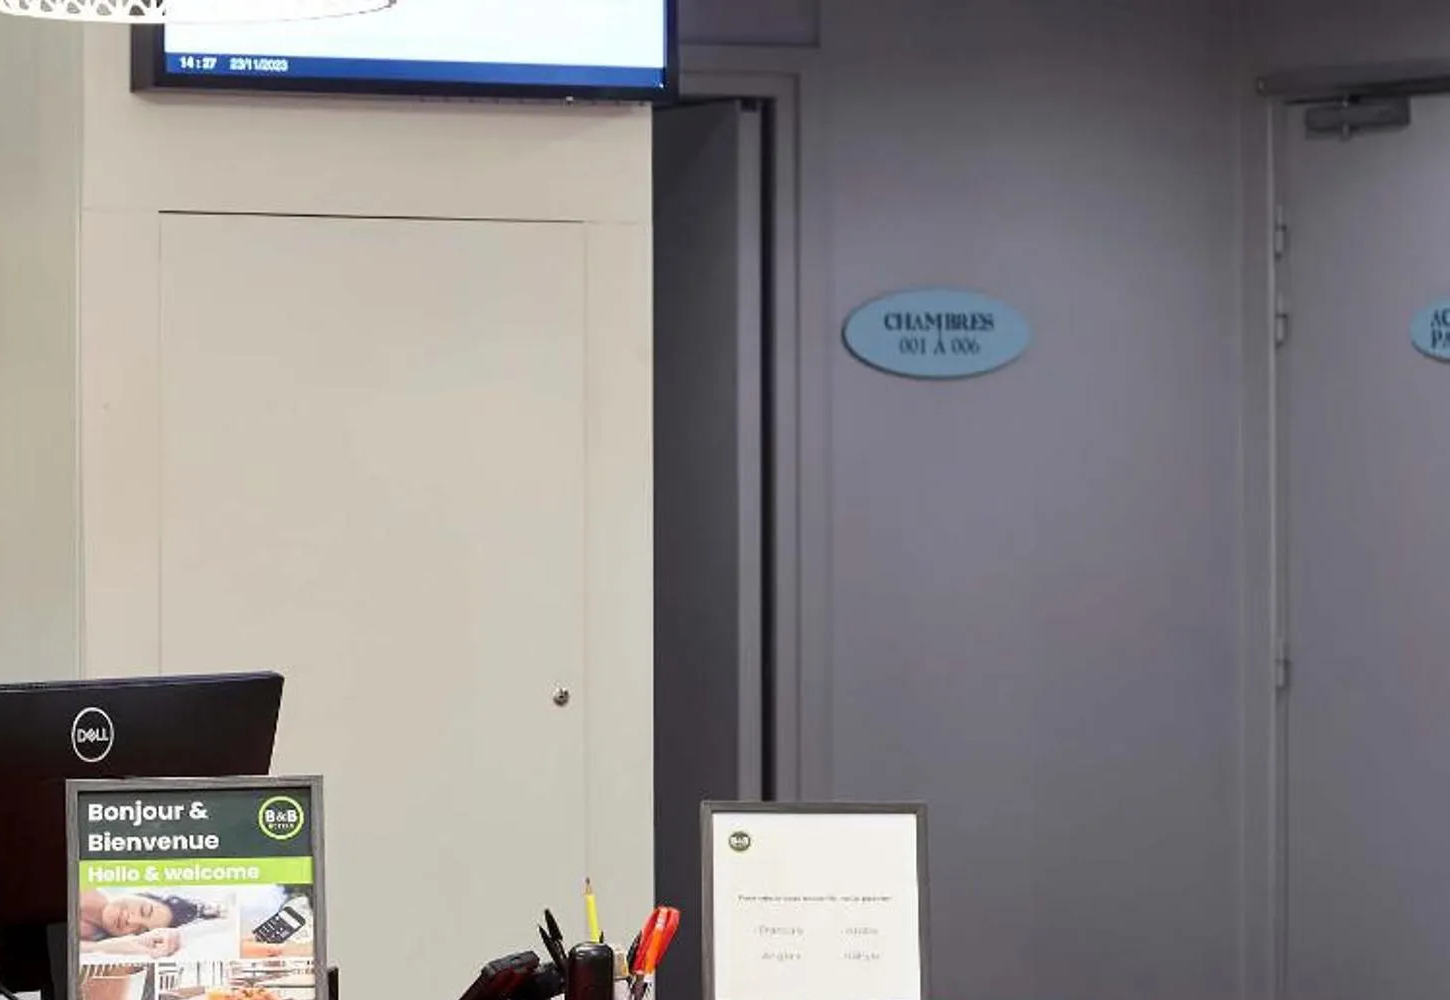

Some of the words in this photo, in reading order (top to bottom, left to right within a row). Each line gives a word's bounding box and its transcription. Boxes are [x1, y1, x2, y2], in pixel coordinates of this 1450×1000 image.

[230, 57, 288, 71] 23/11/2023
[883, 312, 996, 331] CHAMBRES
[899, 337, 926, 355] 001
[951, 337, 980, 354] 006
[76, 728, 109, 743] DELL
[87, 801, 185, 827] Bonjour
[189, 802, 209, 820] &
[265, 809, 298, 823] B&B
[87, 832, 220, 852] Bienvenue
[87, 864, 140, 883] Hello
[144, 864, 160, 882] &
[164, 864, 259, 881] welcome
